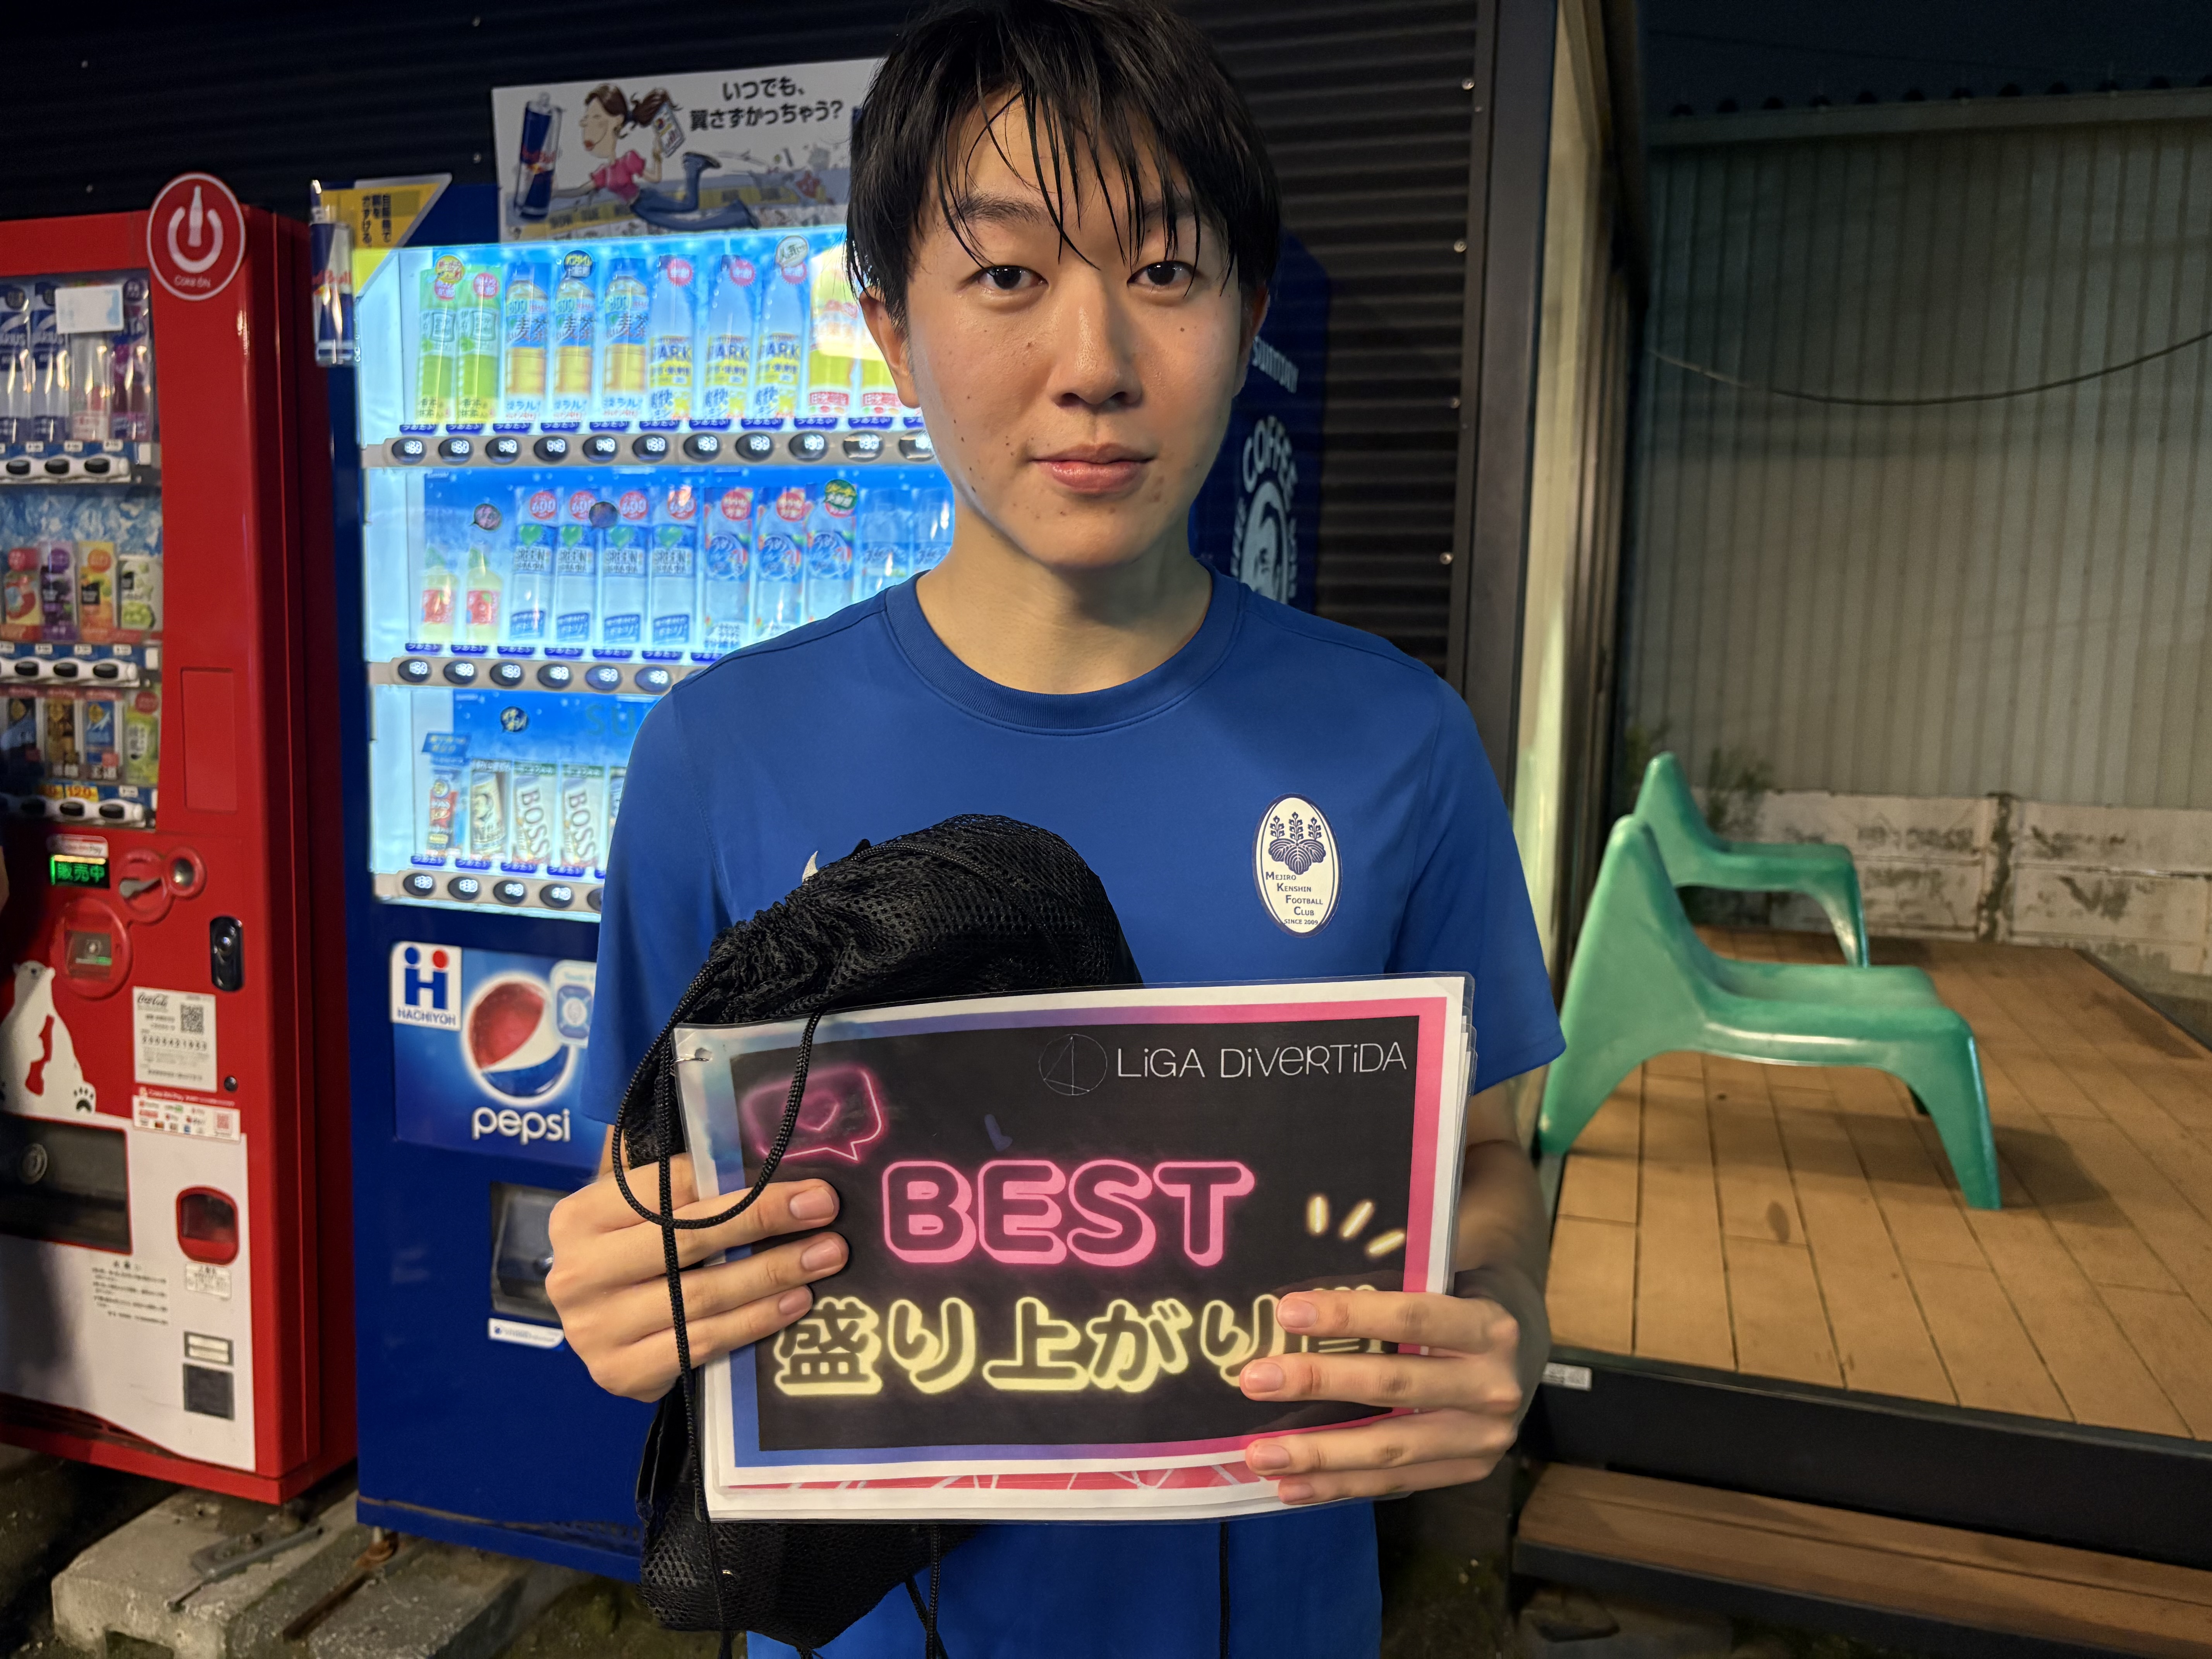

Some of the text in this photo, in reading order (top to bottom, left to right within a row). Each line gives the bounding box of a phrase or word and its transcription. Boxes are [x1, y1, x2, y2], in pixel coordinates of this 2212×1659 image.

[723, 76, 805, 101] いつでも、
[521, 790, 550, 855] BOSS
[568, 792, 596, 858] BOSS
[1266, 871, 1296, 881] MEJIRO
[1277, 883, 1311, 892] KENSHIN
[1286, 895, 1323, 905] FOOTBALL
[1293, 906, 1314, 916] CLUB
[397, 1008, 456, 1026] HACHIYOH
[472, 1106, 571, 1145] pepsi
[881, 1159, 1255, 1267] BEST
[774, 1285, 1385, 1396] 盛り上がり
